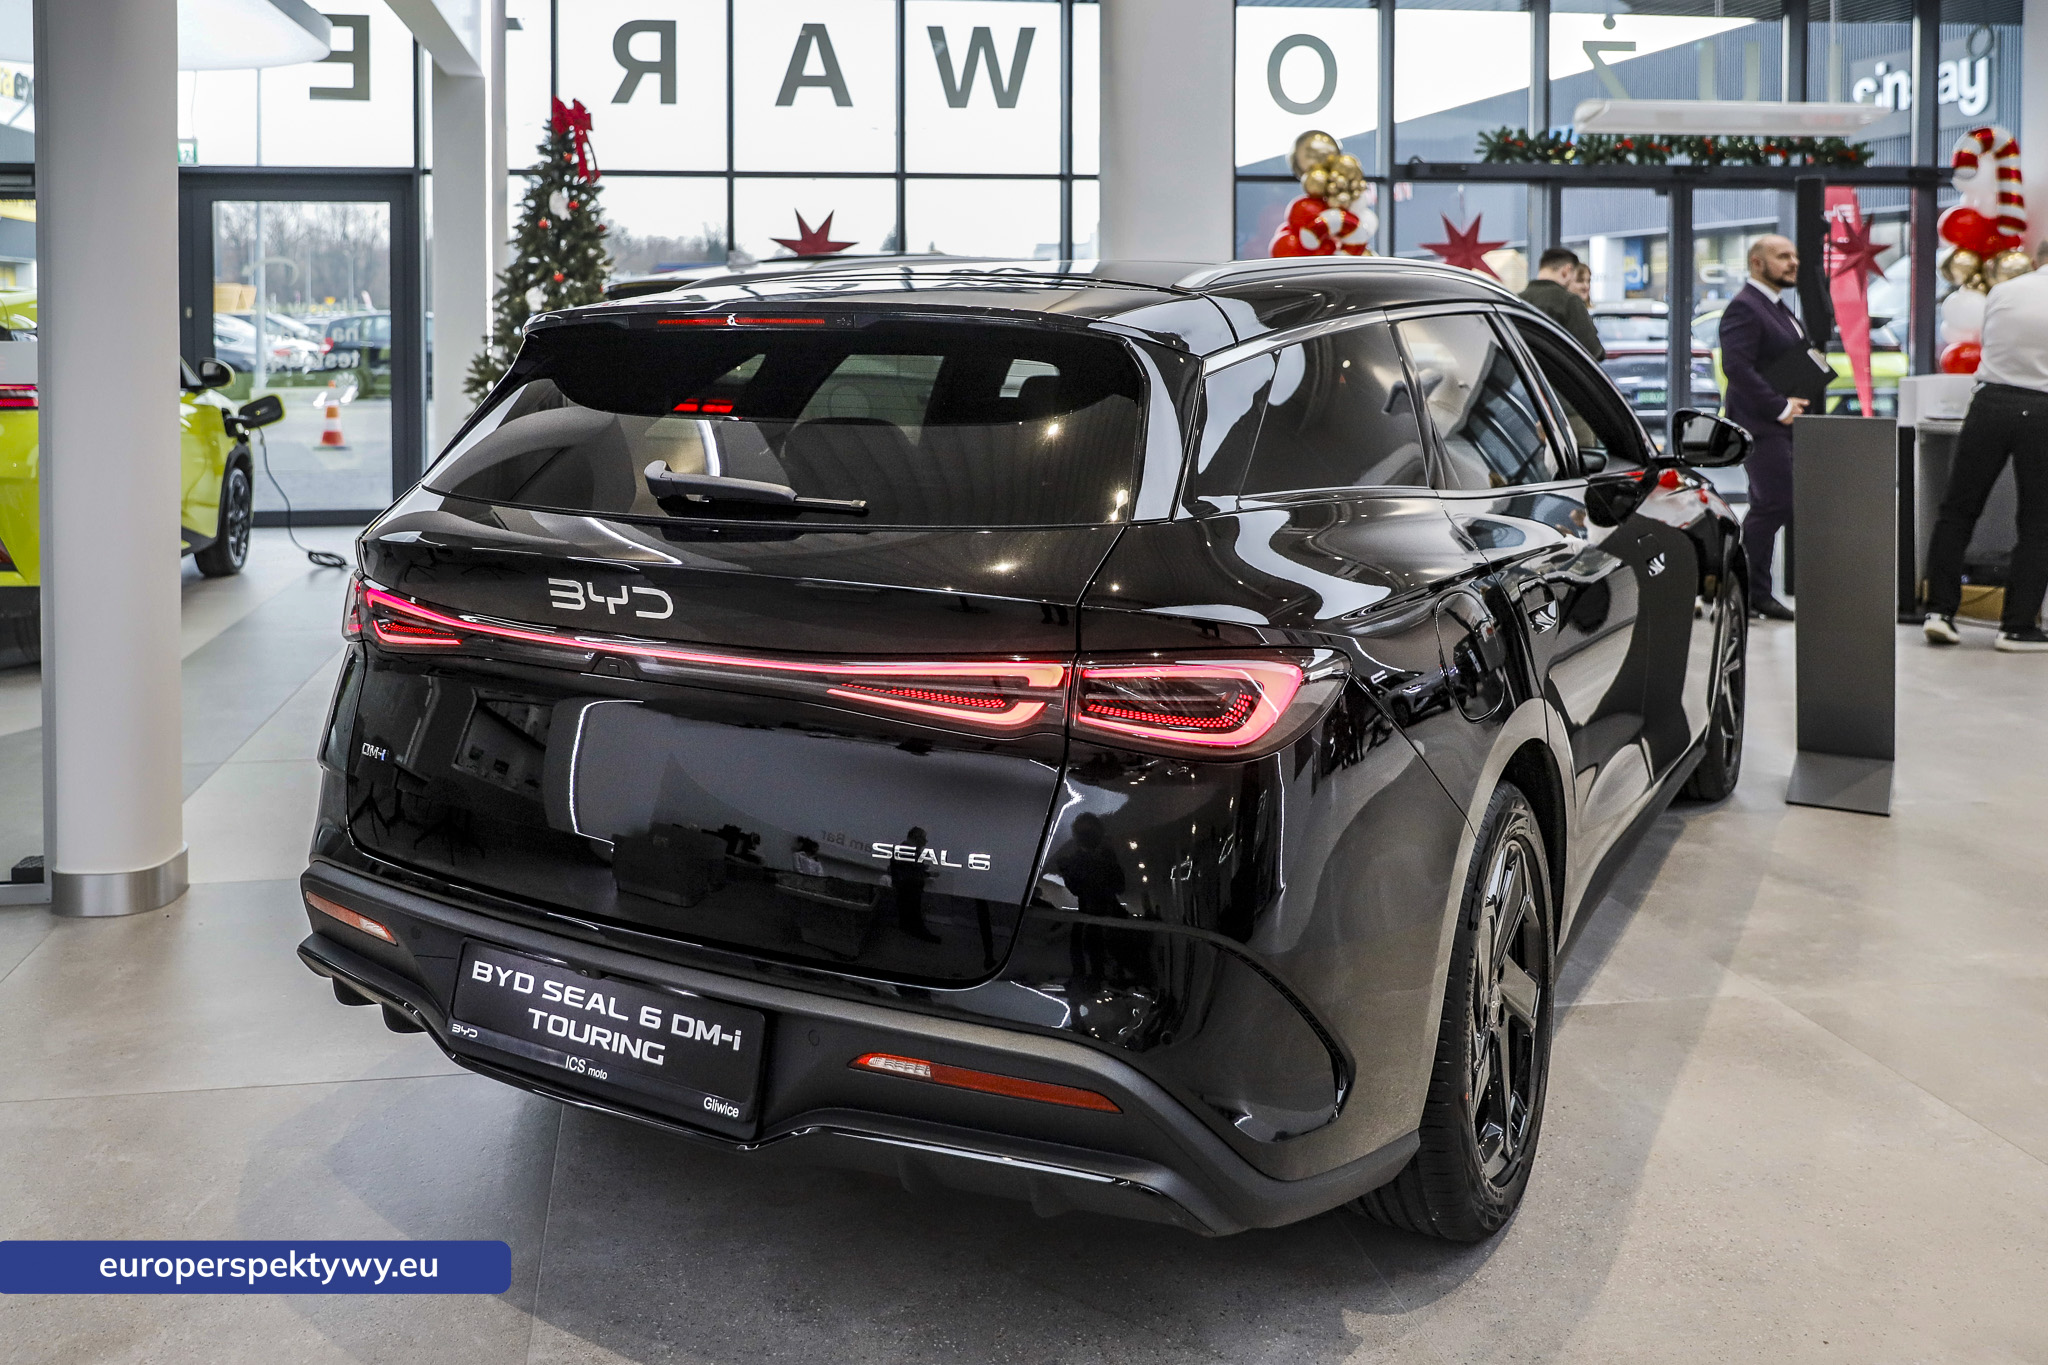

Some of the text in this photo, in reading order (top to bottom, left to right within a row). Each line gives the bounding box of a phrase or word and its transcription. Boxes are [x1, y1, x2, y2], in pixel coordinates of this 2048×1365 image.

[1852, 56, 1990, 117] sinay
[548, 577, 674, 619] BYD
[871, 842, 962, 868] SEAL
[967, 853, 991, 871] 6
[471, 960, 742, 1051] BYD SEAL 6 DM-i
[451, 1023, 478, 1038] BYD
[527, 1007, 666, 1066] TOURING
[565, 1054, 608, 1080] ICS moto
[703, 1096, 740, 1118] Gliwice
